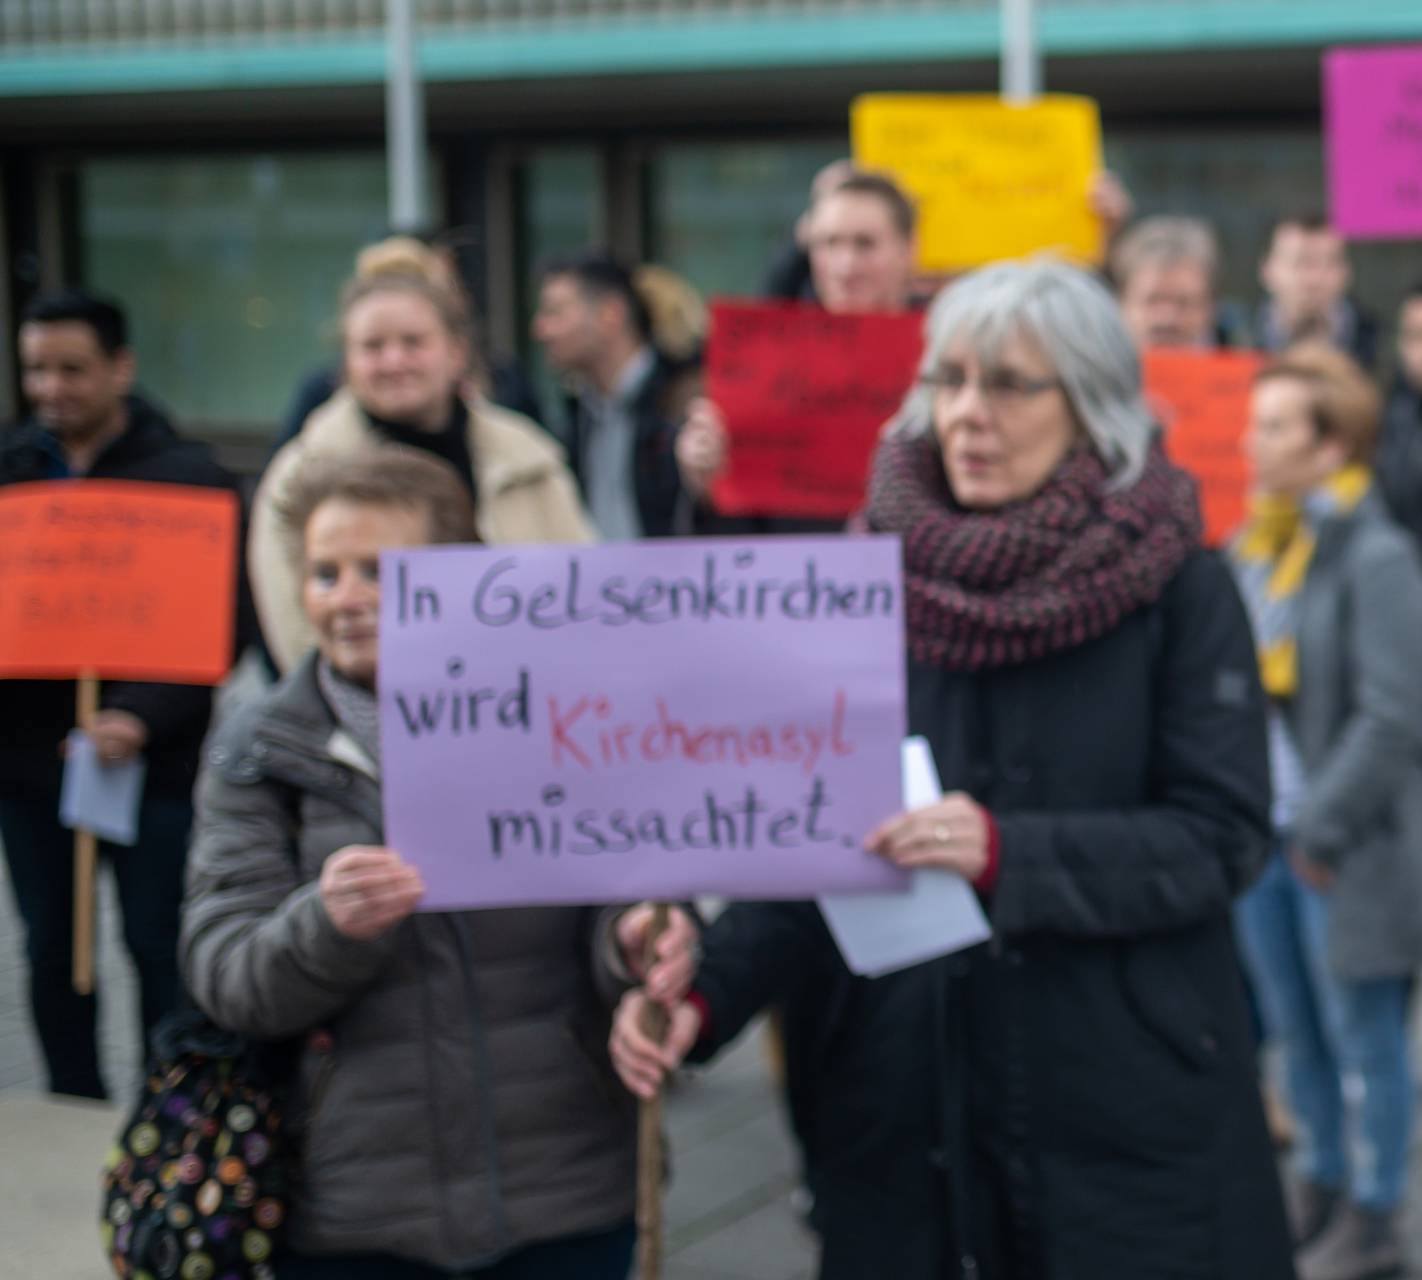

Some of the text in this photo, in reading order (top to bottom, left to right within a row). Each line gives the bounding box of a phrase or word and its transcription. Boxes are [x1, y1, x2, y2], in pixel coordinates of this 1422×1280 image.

[396, 549, 895, 628] In Gelsenkirchen
[395, 656, 858, 774] wird Kirchenasyl
[487, 774, 857, 860] missachtet.
